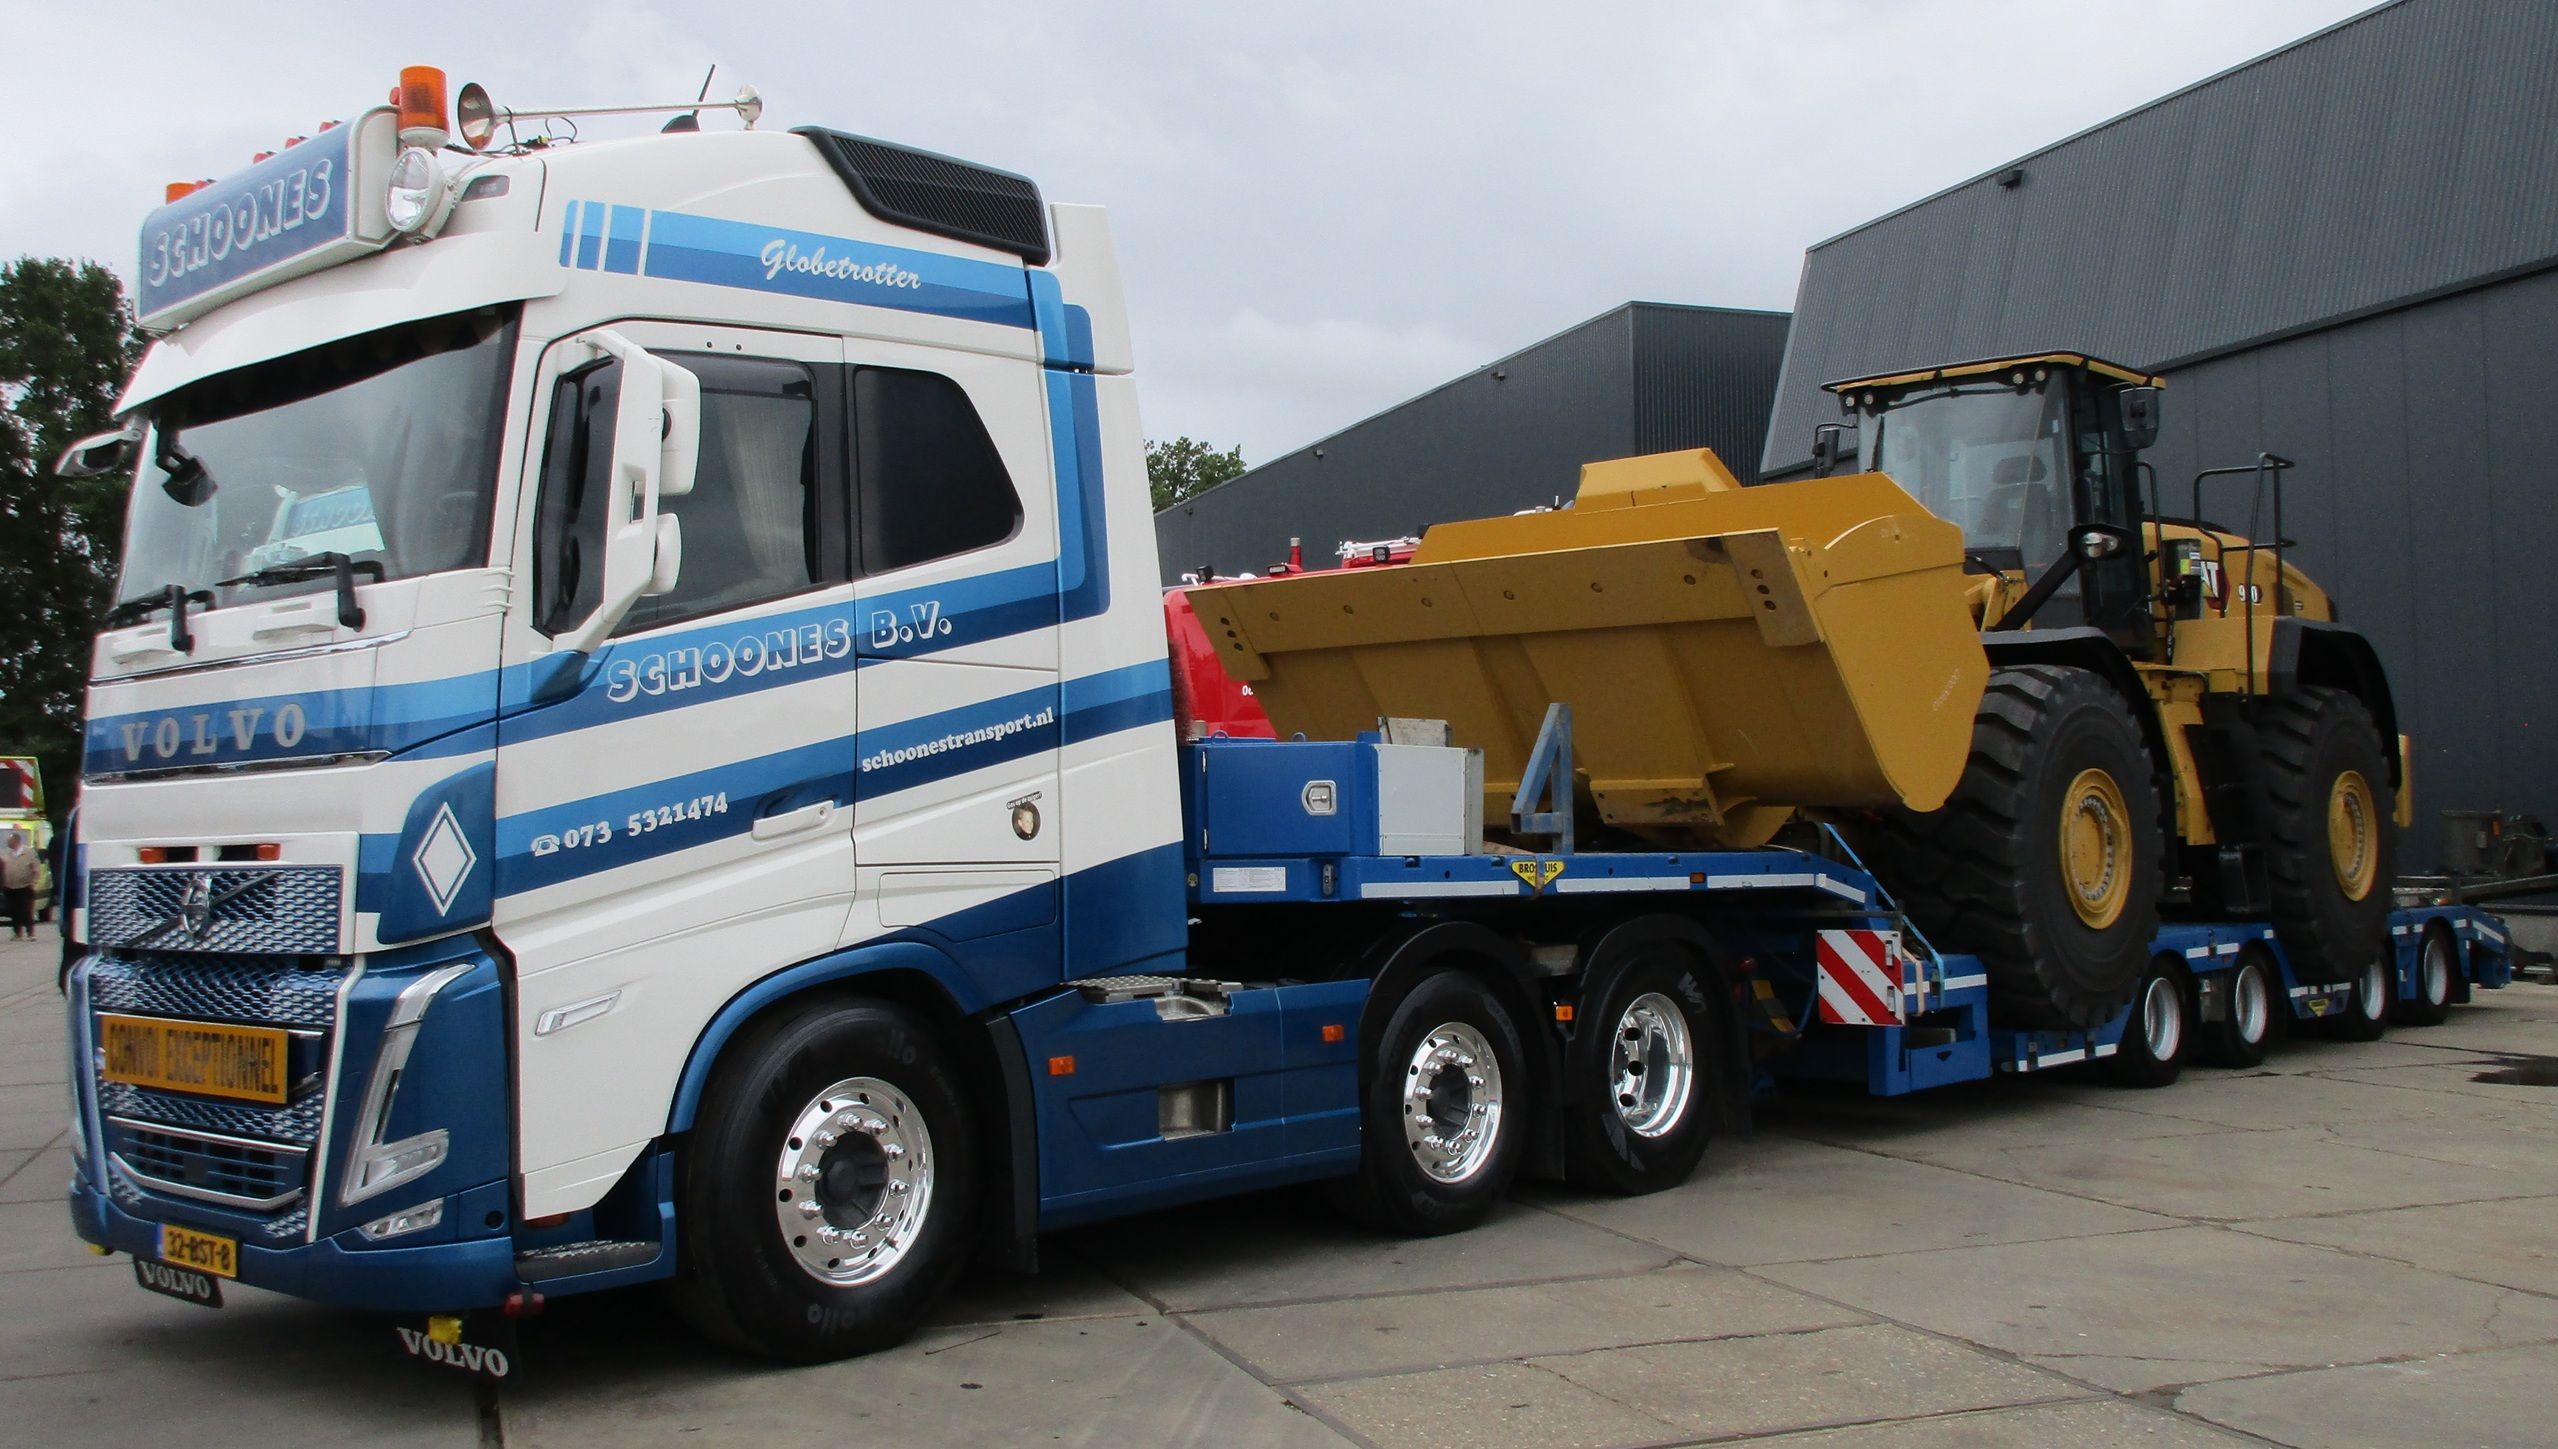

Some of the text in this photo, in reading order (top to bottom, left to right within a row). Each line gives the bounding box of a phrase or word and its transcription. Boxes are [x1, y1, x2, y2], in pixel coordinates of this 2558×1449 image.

[149, 158, 334, 288] SCHOONES
[761, 239, 922, 290] Globetrotter
[607, 601, 952, 703] SCHOONES B.V.
[120, 703, 306, 762] VOLVO
[862, 706, 1055, 773] schoonestransport.nl
[563, 791, 728, 849] 073 5321474
[140, 1260, 212, 1299] VOLVO
[168, 1230, 231, 1271] 32-BST-8
[396, 1326, 509, 1377] VOLVO
